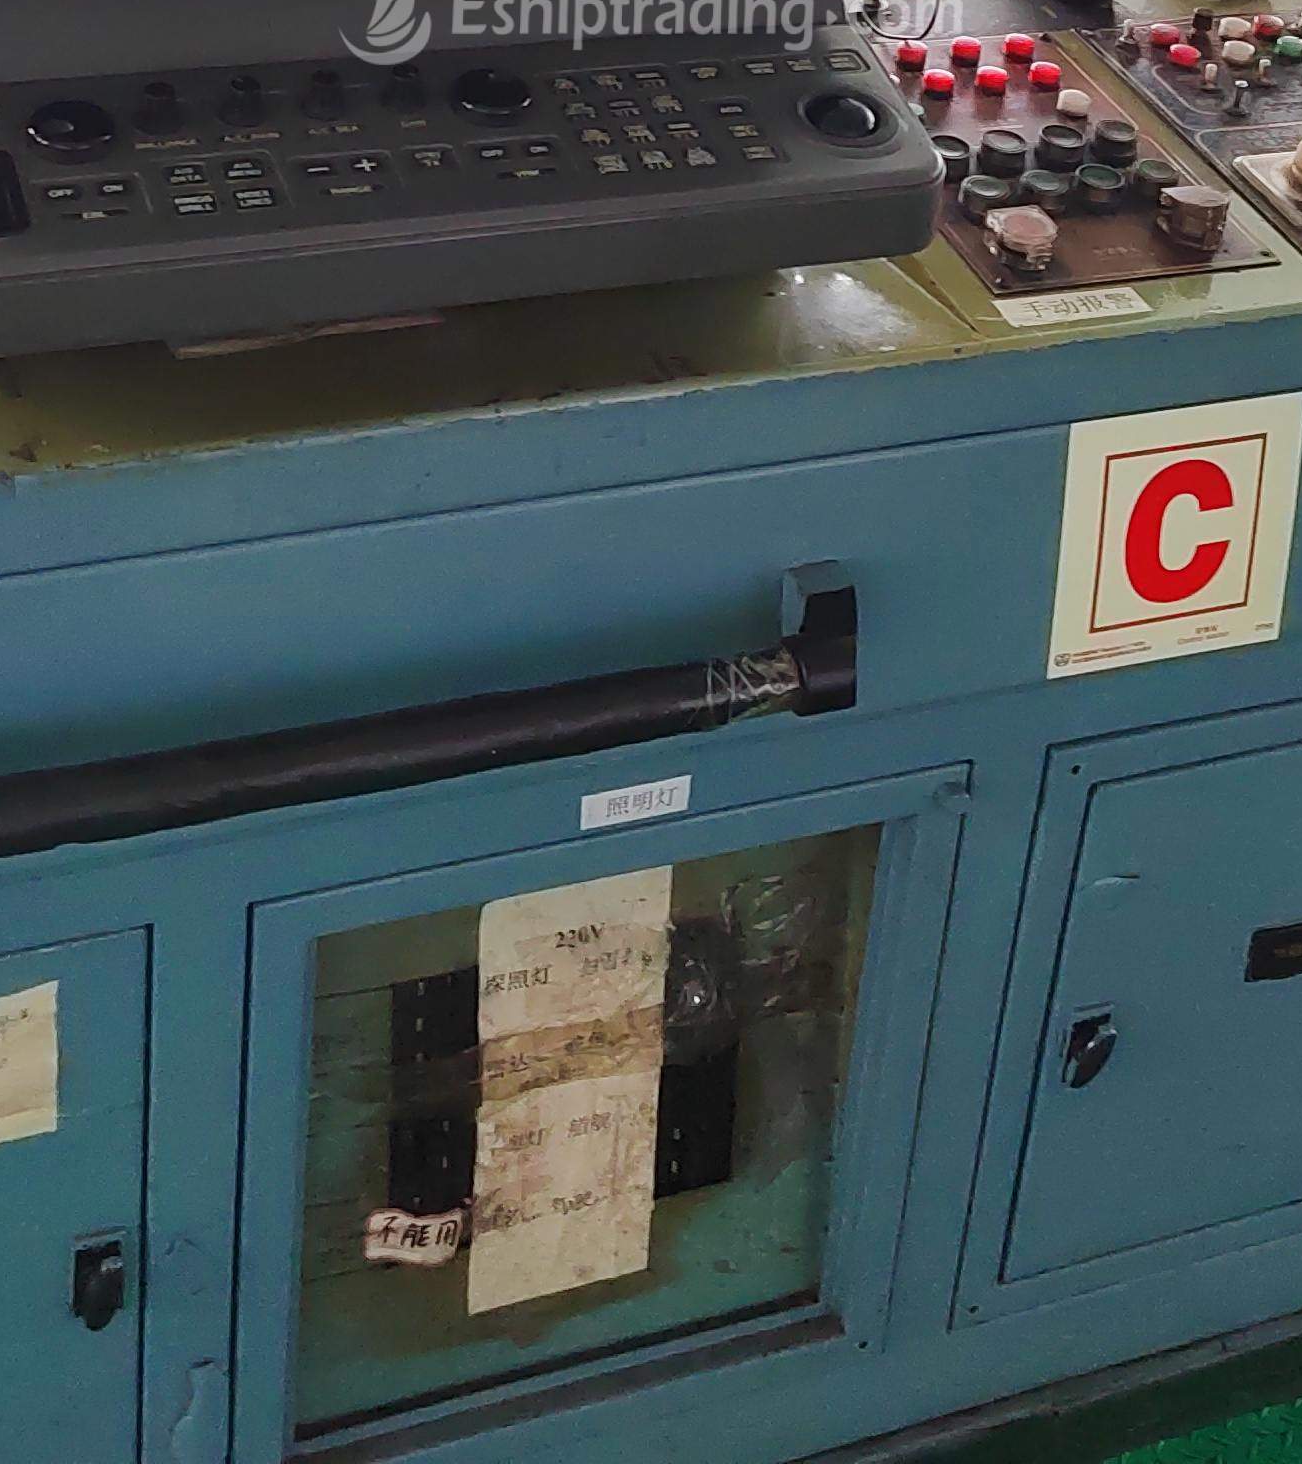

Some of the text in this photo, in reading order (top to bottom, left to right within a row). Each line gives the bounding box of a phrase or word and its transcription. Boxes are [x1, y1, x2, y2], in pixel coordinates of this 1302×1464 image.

[47, 187, 75, 198] OFF
[1125, 459, 1234, 604] C
[605, 786, 678, 818] 照明灯
[555, 922, 607, 949] 220V
[379, 1216, 459, 1249] 不能用
